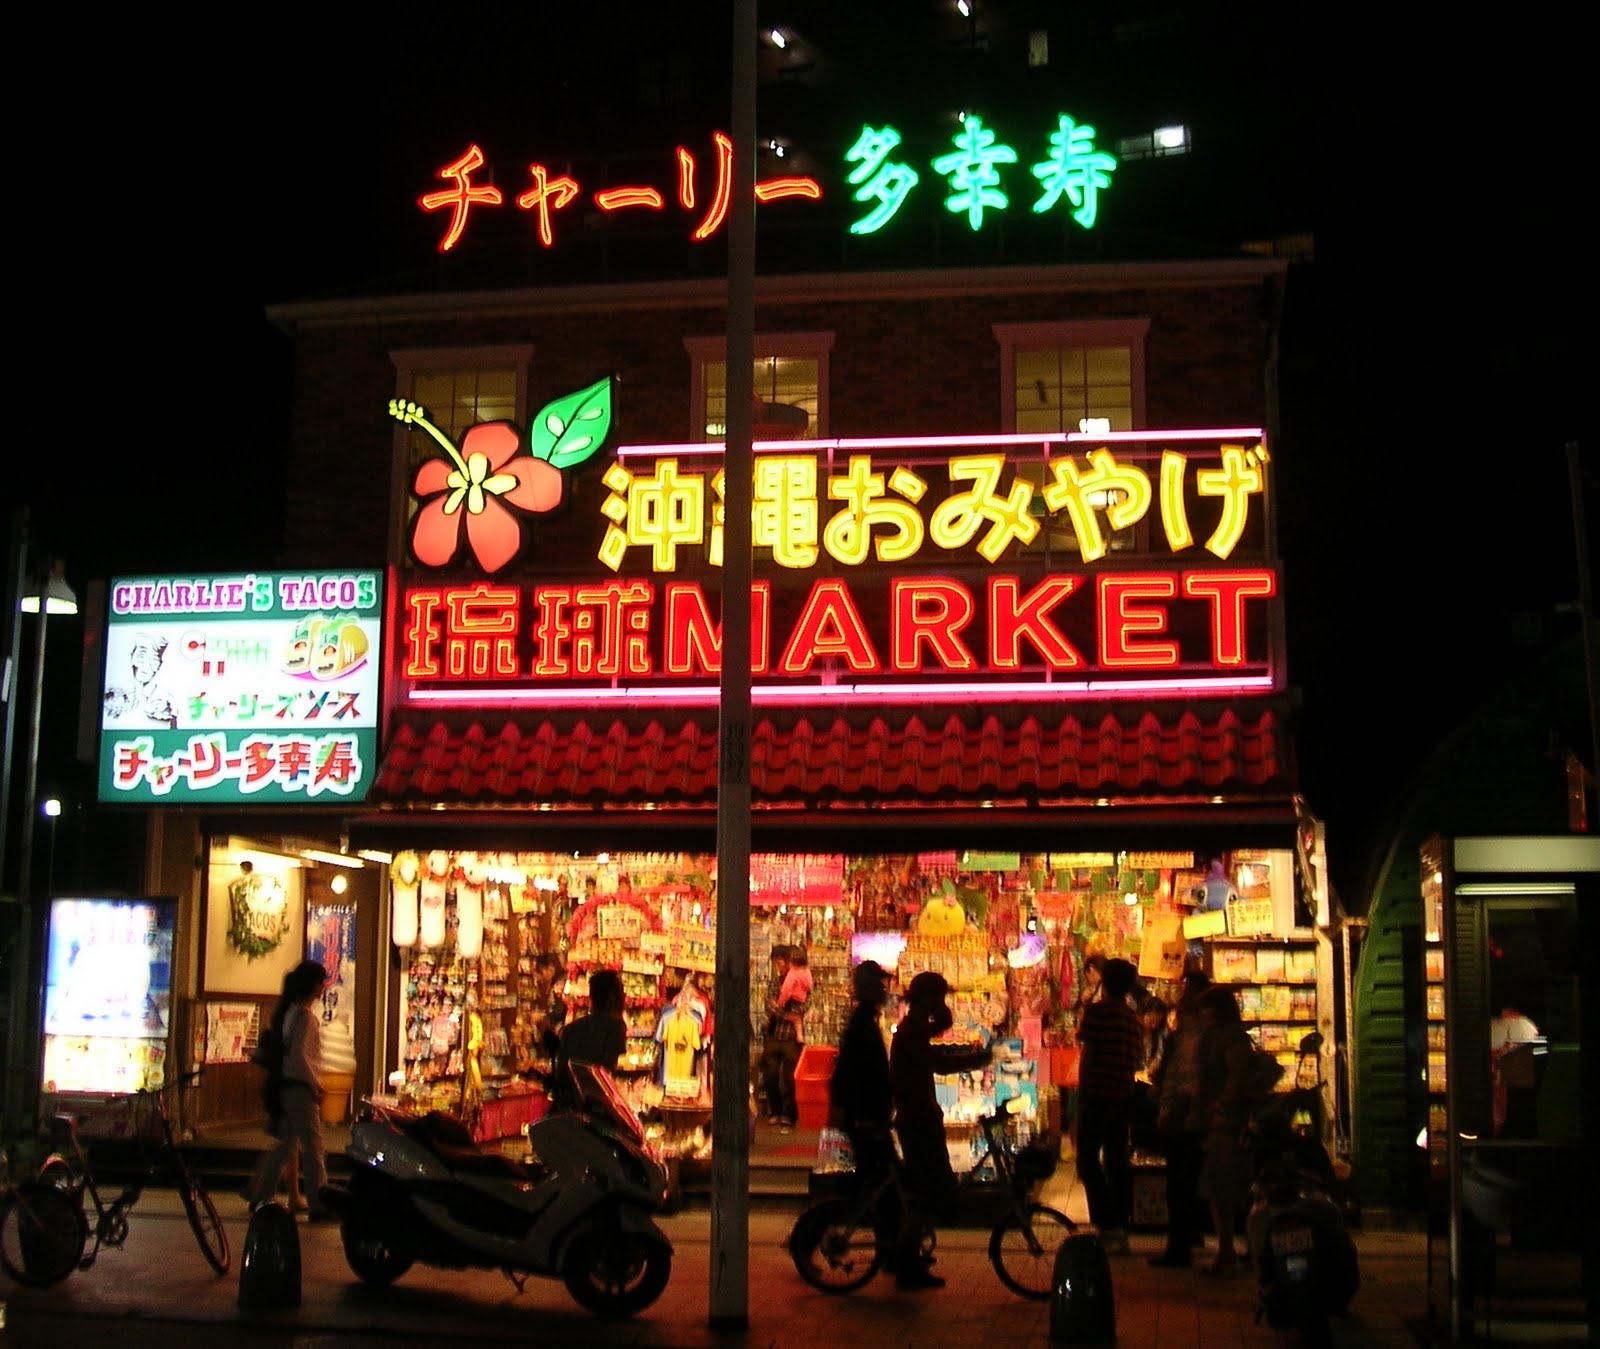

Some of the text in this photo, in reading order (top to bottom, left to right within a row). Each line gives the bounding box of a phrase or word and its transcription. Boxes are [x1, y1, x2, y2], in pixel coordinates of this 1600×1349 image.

[598, 443, 1270, 573] 沖縄おみやげ
[114, 575, 376, 611] CHARLIE'S TACOS
